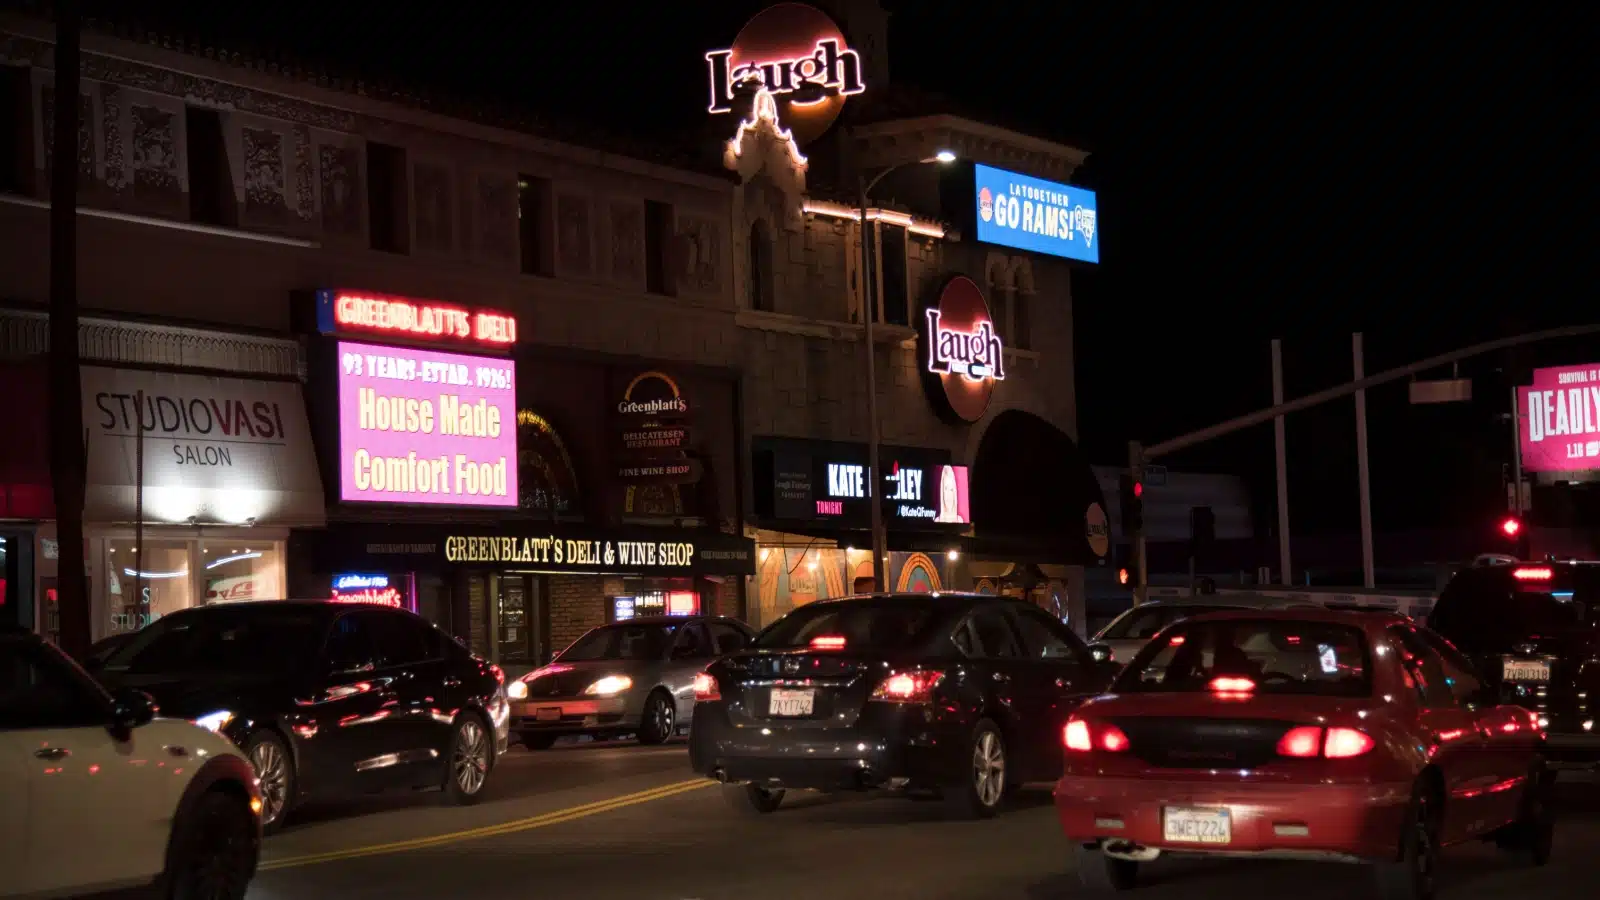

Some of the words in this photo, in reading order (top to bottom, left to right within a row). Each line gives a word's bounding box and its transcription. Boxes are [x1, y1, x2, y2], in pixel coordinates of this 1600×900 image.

[994, 193, 1020, 229] GO
[1022, 200, 1074, 241] RAMS!
[477, 313, 516, 342] DELI
[926, 308, 1005, 382] Laugh
[343, 352, 363, 376] 93
[475, 366, 512, 390] 1926!
[1558, 371, 1588, 384] SURVIVAL
[359, 387, 434, 434] House
[439, 394, 501, 439] Made
[617, 396, 688, 414] Greenblatt's
[623, 430, 685, 441] DELICATESSEN
[173, 445, 233, 466] SALON
[641, 466, 665, 476] WINE
[666, 465, 690, 475] SHOP
[354, 447, 450, 494] Comfort
[455, 453, 507, 497] Food
[828, 463, 864, 498] KATE
[816, 501, 843, 514] TONIGHT
[445, 534, 563, 564] GREENBLATT'S
[567, 540, 601, 565] DELI
[604, 541, 615, 565] &
[618, 541, 656, 566] WINE
[658, 542, 694, 566] SHOP
